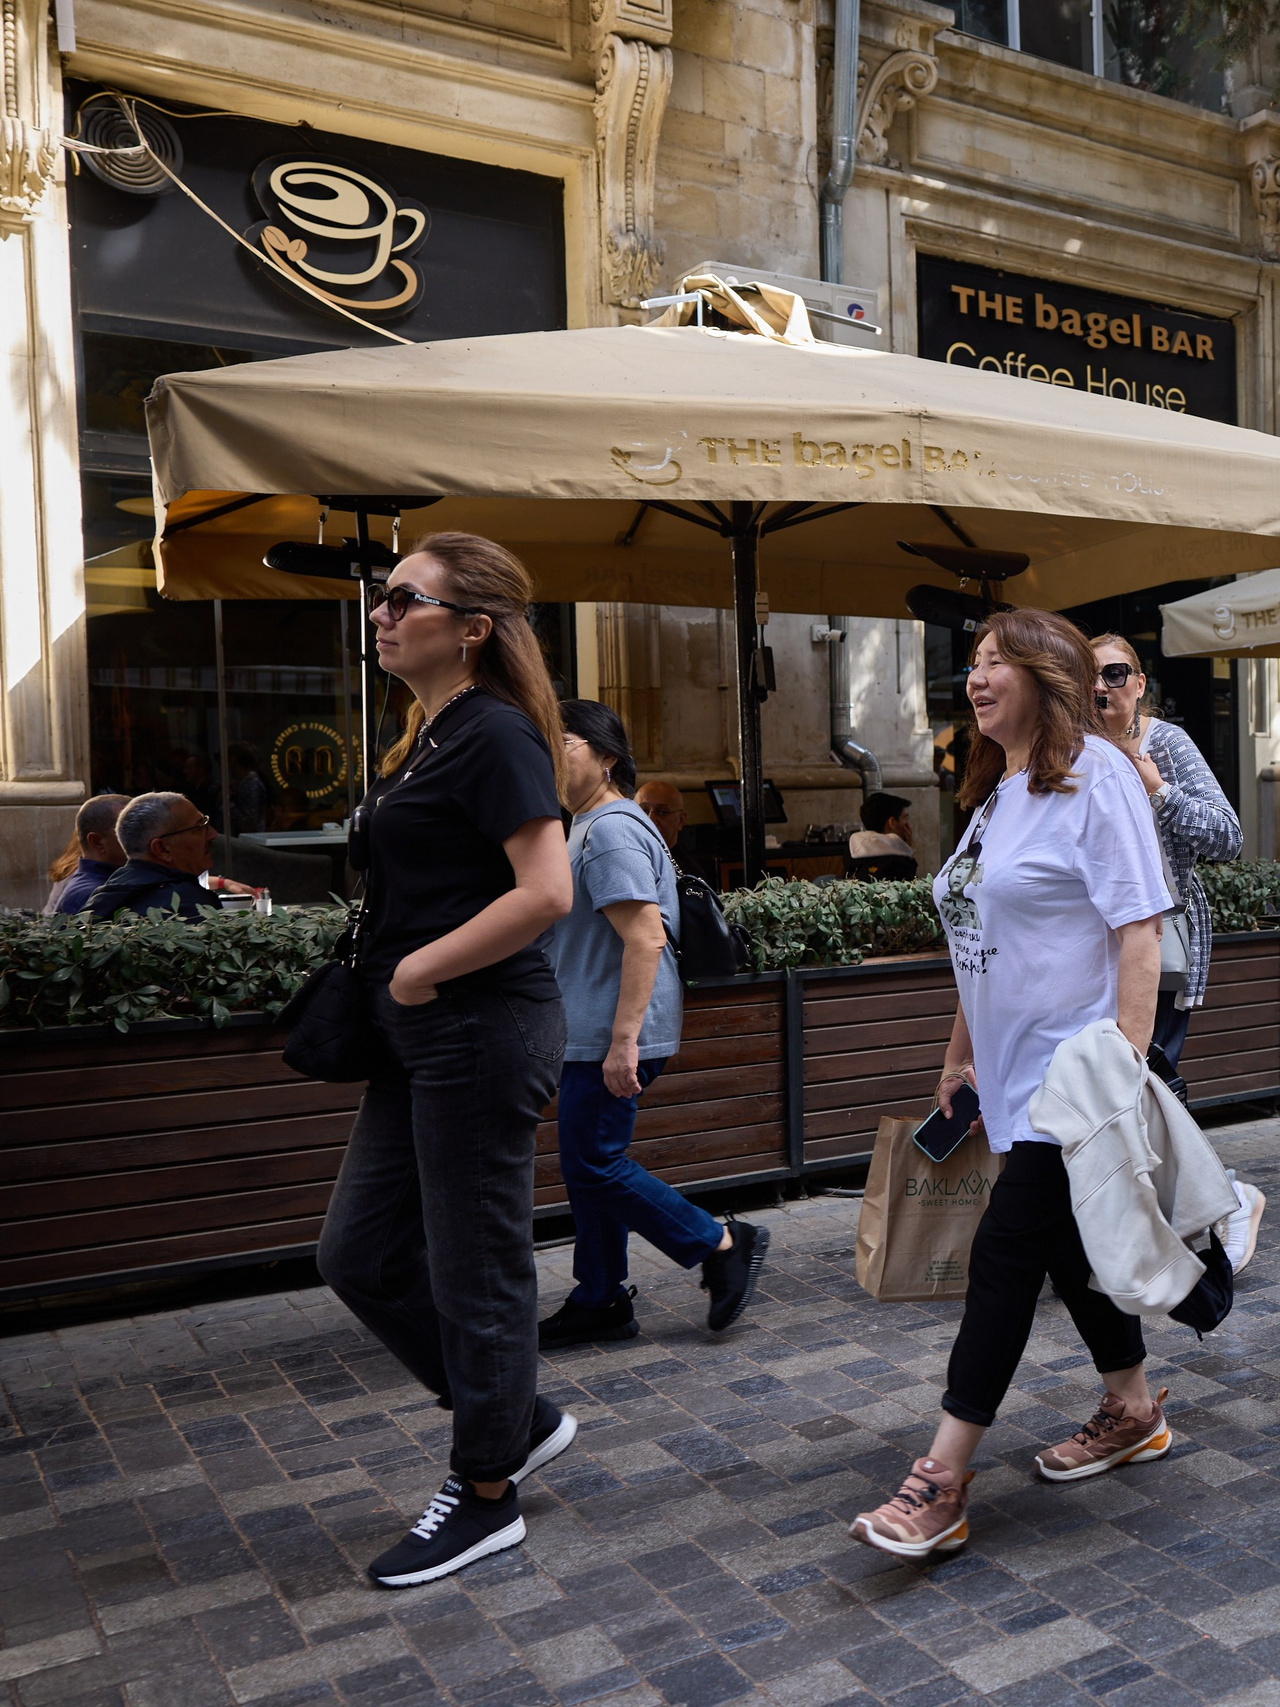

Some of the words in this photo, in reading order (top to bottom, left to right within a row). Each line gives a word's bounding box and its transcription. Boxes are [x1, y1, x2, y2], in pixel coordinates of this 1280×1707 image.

[951, 285, 1024, 324] THE
[1035, 293, 1142, 349] bagel
[1152, 325, 1215, 361] BAR
[1087, 365, 1186, 414] House
[698, 437, 782, 468] THE
[793, 432, 911, 480] bagel
[923, 445, 996, 478] BA
[1241, 609, 1278, 629] THE
[905, 1169, 993, 1196] BAKLAVA
[920, 1199, 948, 1207] SWEET
